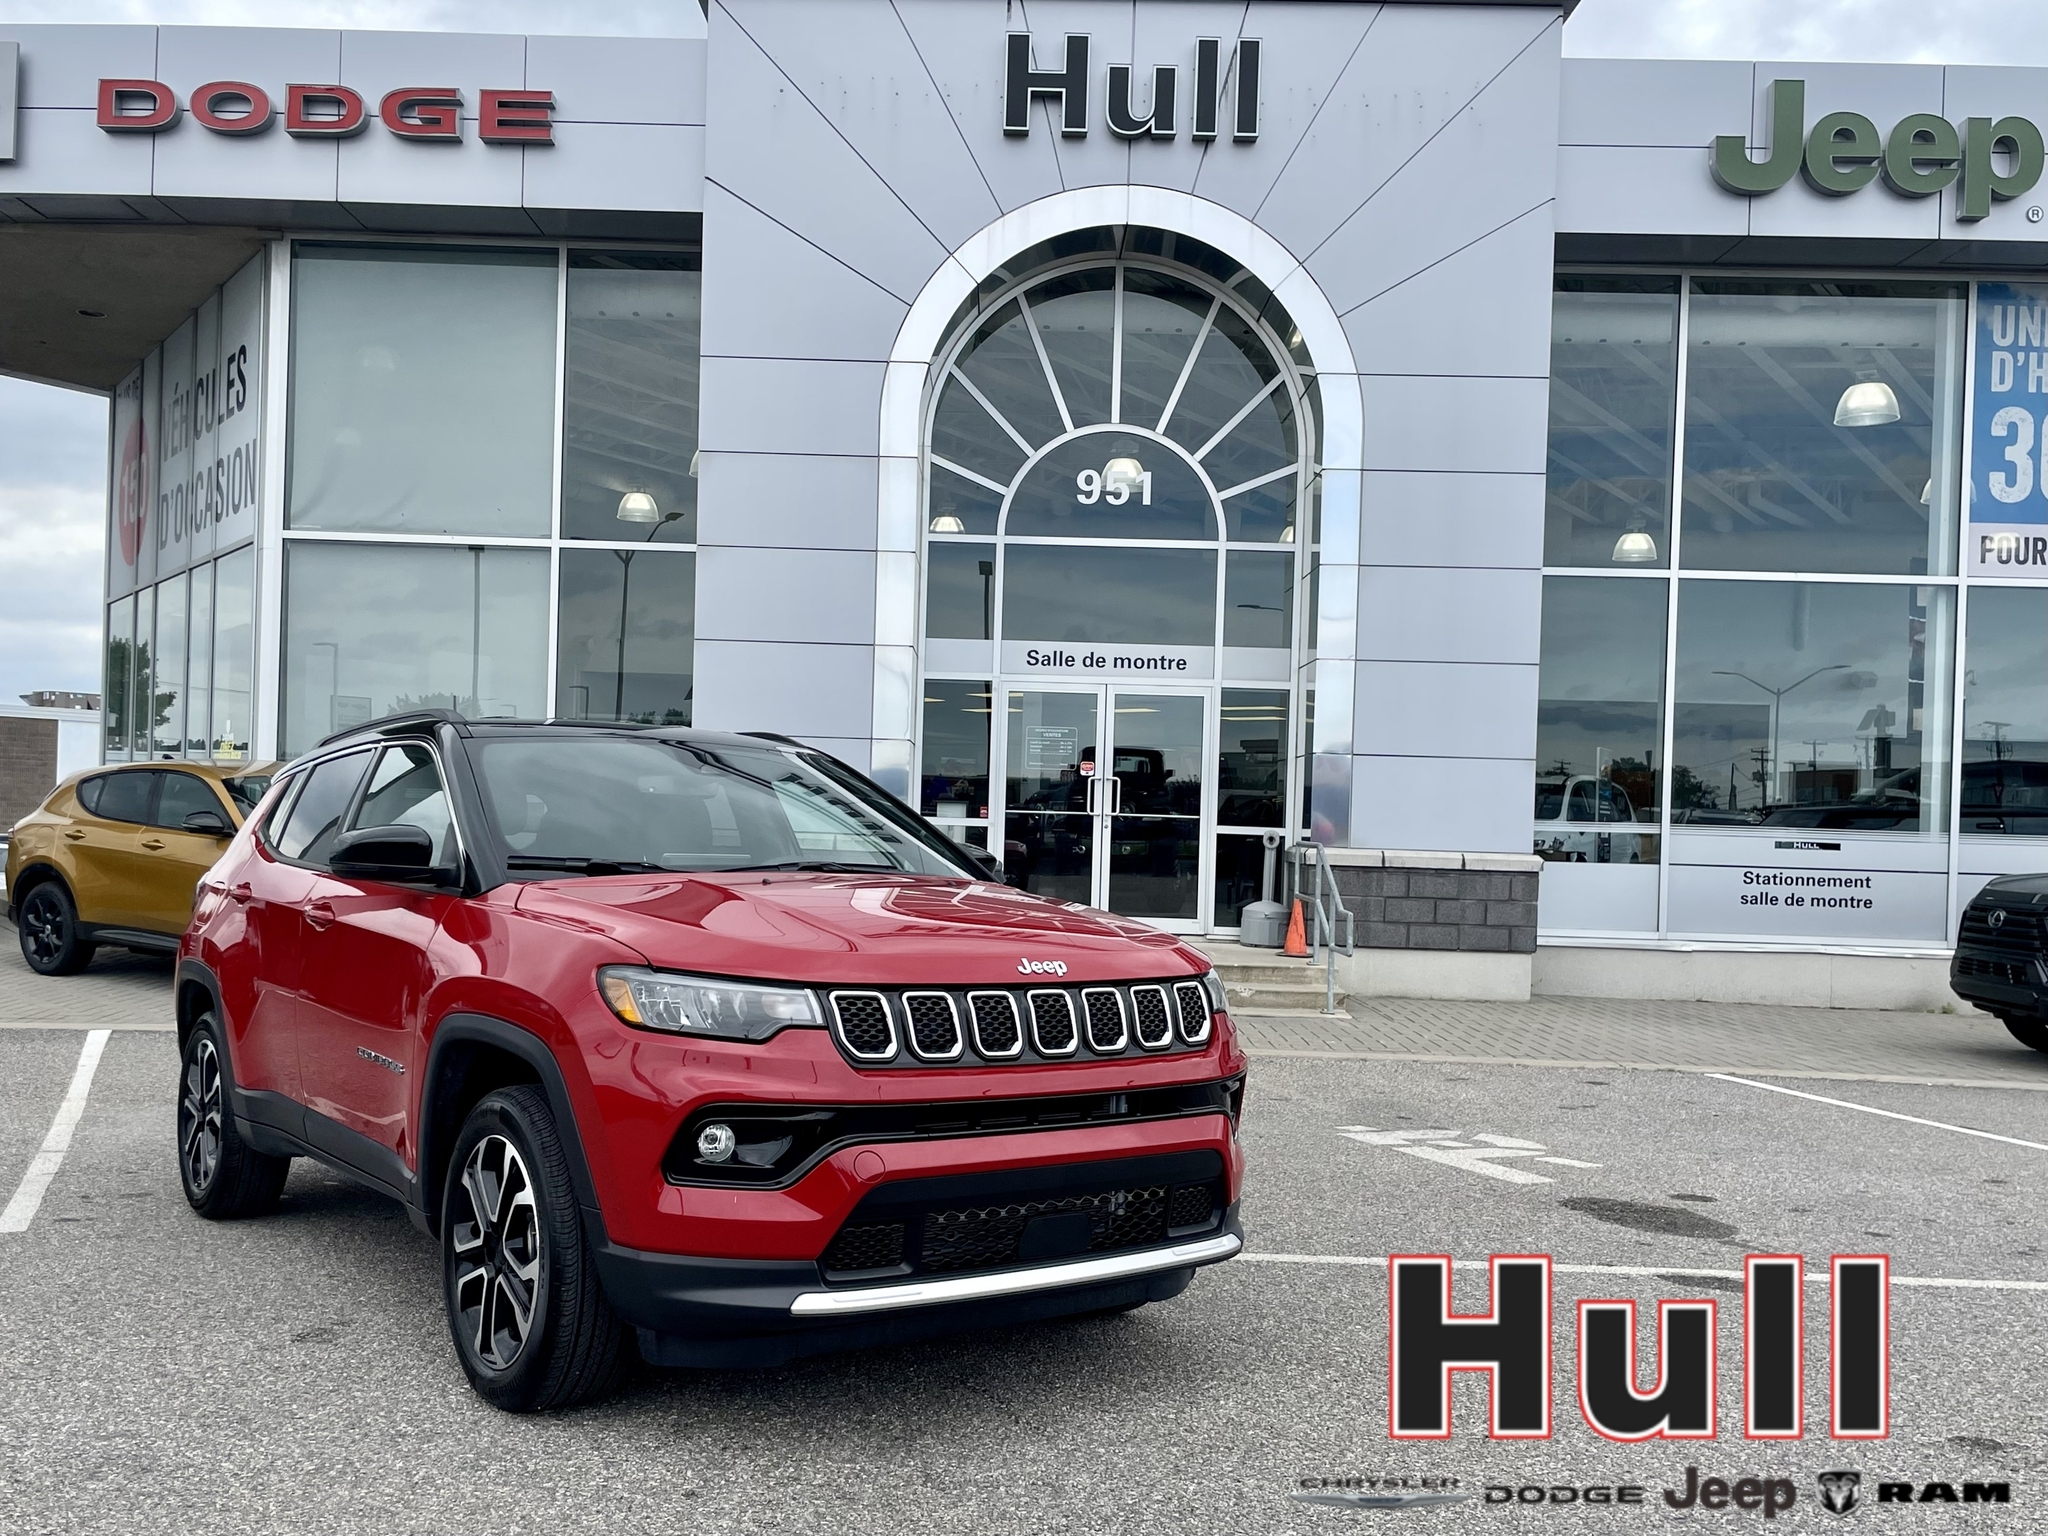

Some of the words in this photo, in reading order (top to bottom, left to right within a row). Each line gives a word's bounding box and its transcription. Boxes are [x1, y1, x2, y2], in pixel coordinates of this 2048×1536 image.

[1002, 31, 1263, 143] Hull
[97, 78, 556, 145] DODGE
[1708, 79, 2045, 222] Jeep
[161, 344, 248, 464] VÉHCULES
[1076, 469, 1152, 506] 951
[1980, 535, 2048, 566] POUR
[1026, 649, 1076, 667] Salle
[1082, 651, 1107, 668] de
[1113, 655, 1188, 671] montre
[1742, 870, 1872, 889] Stationnement
[1740, 891, 1779, 906] salle
[1784, 892, 1805, 907] de
[1810, 896, 1873, 909] montre
[1016, 957, 1068, 978] Jeep
